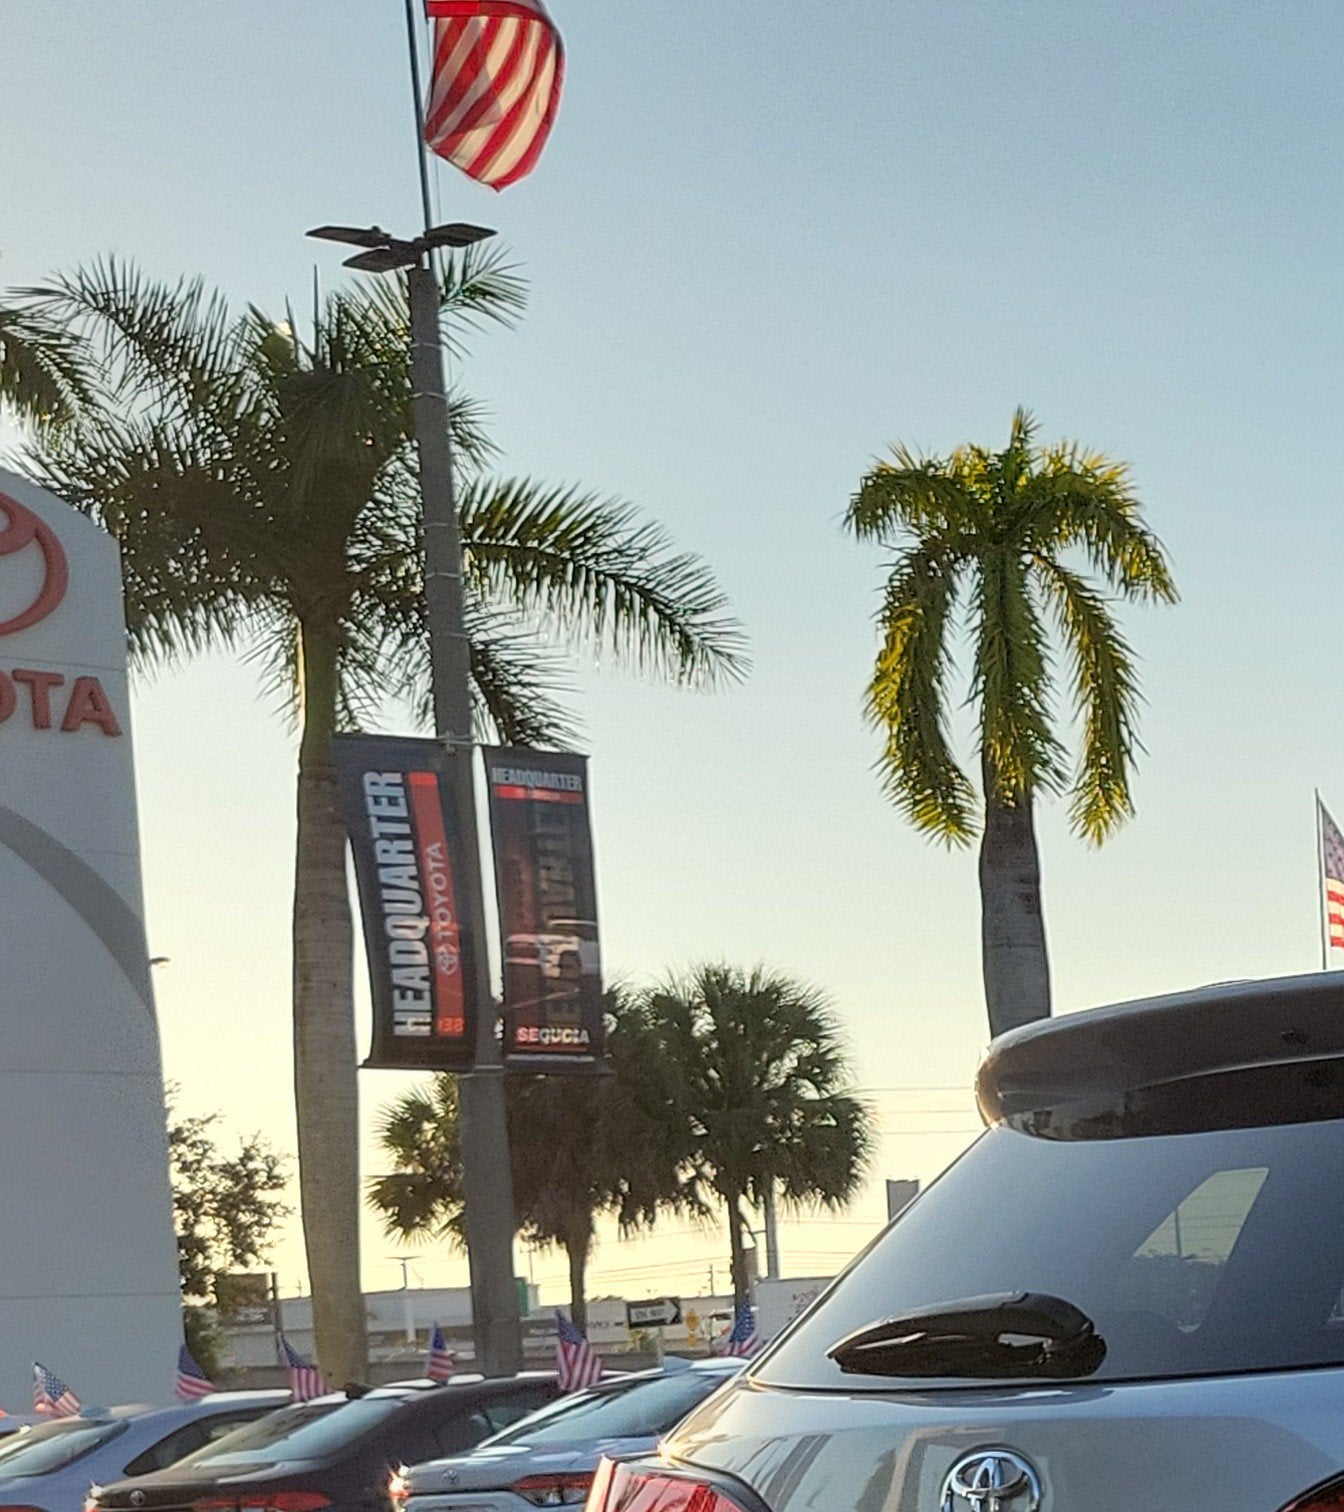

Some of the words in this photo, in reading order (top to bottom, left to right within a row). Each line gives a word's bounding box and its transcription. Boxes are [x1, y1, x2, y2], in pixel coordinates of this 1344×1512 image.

[491, 767, 583, 791] HEADQUARTER
[363, 771, 432, 1036] HEADQUARTER
[427, 842, 454, 940] TOYOTA
[517, 1027, 590, 1044] SEQUOIA
